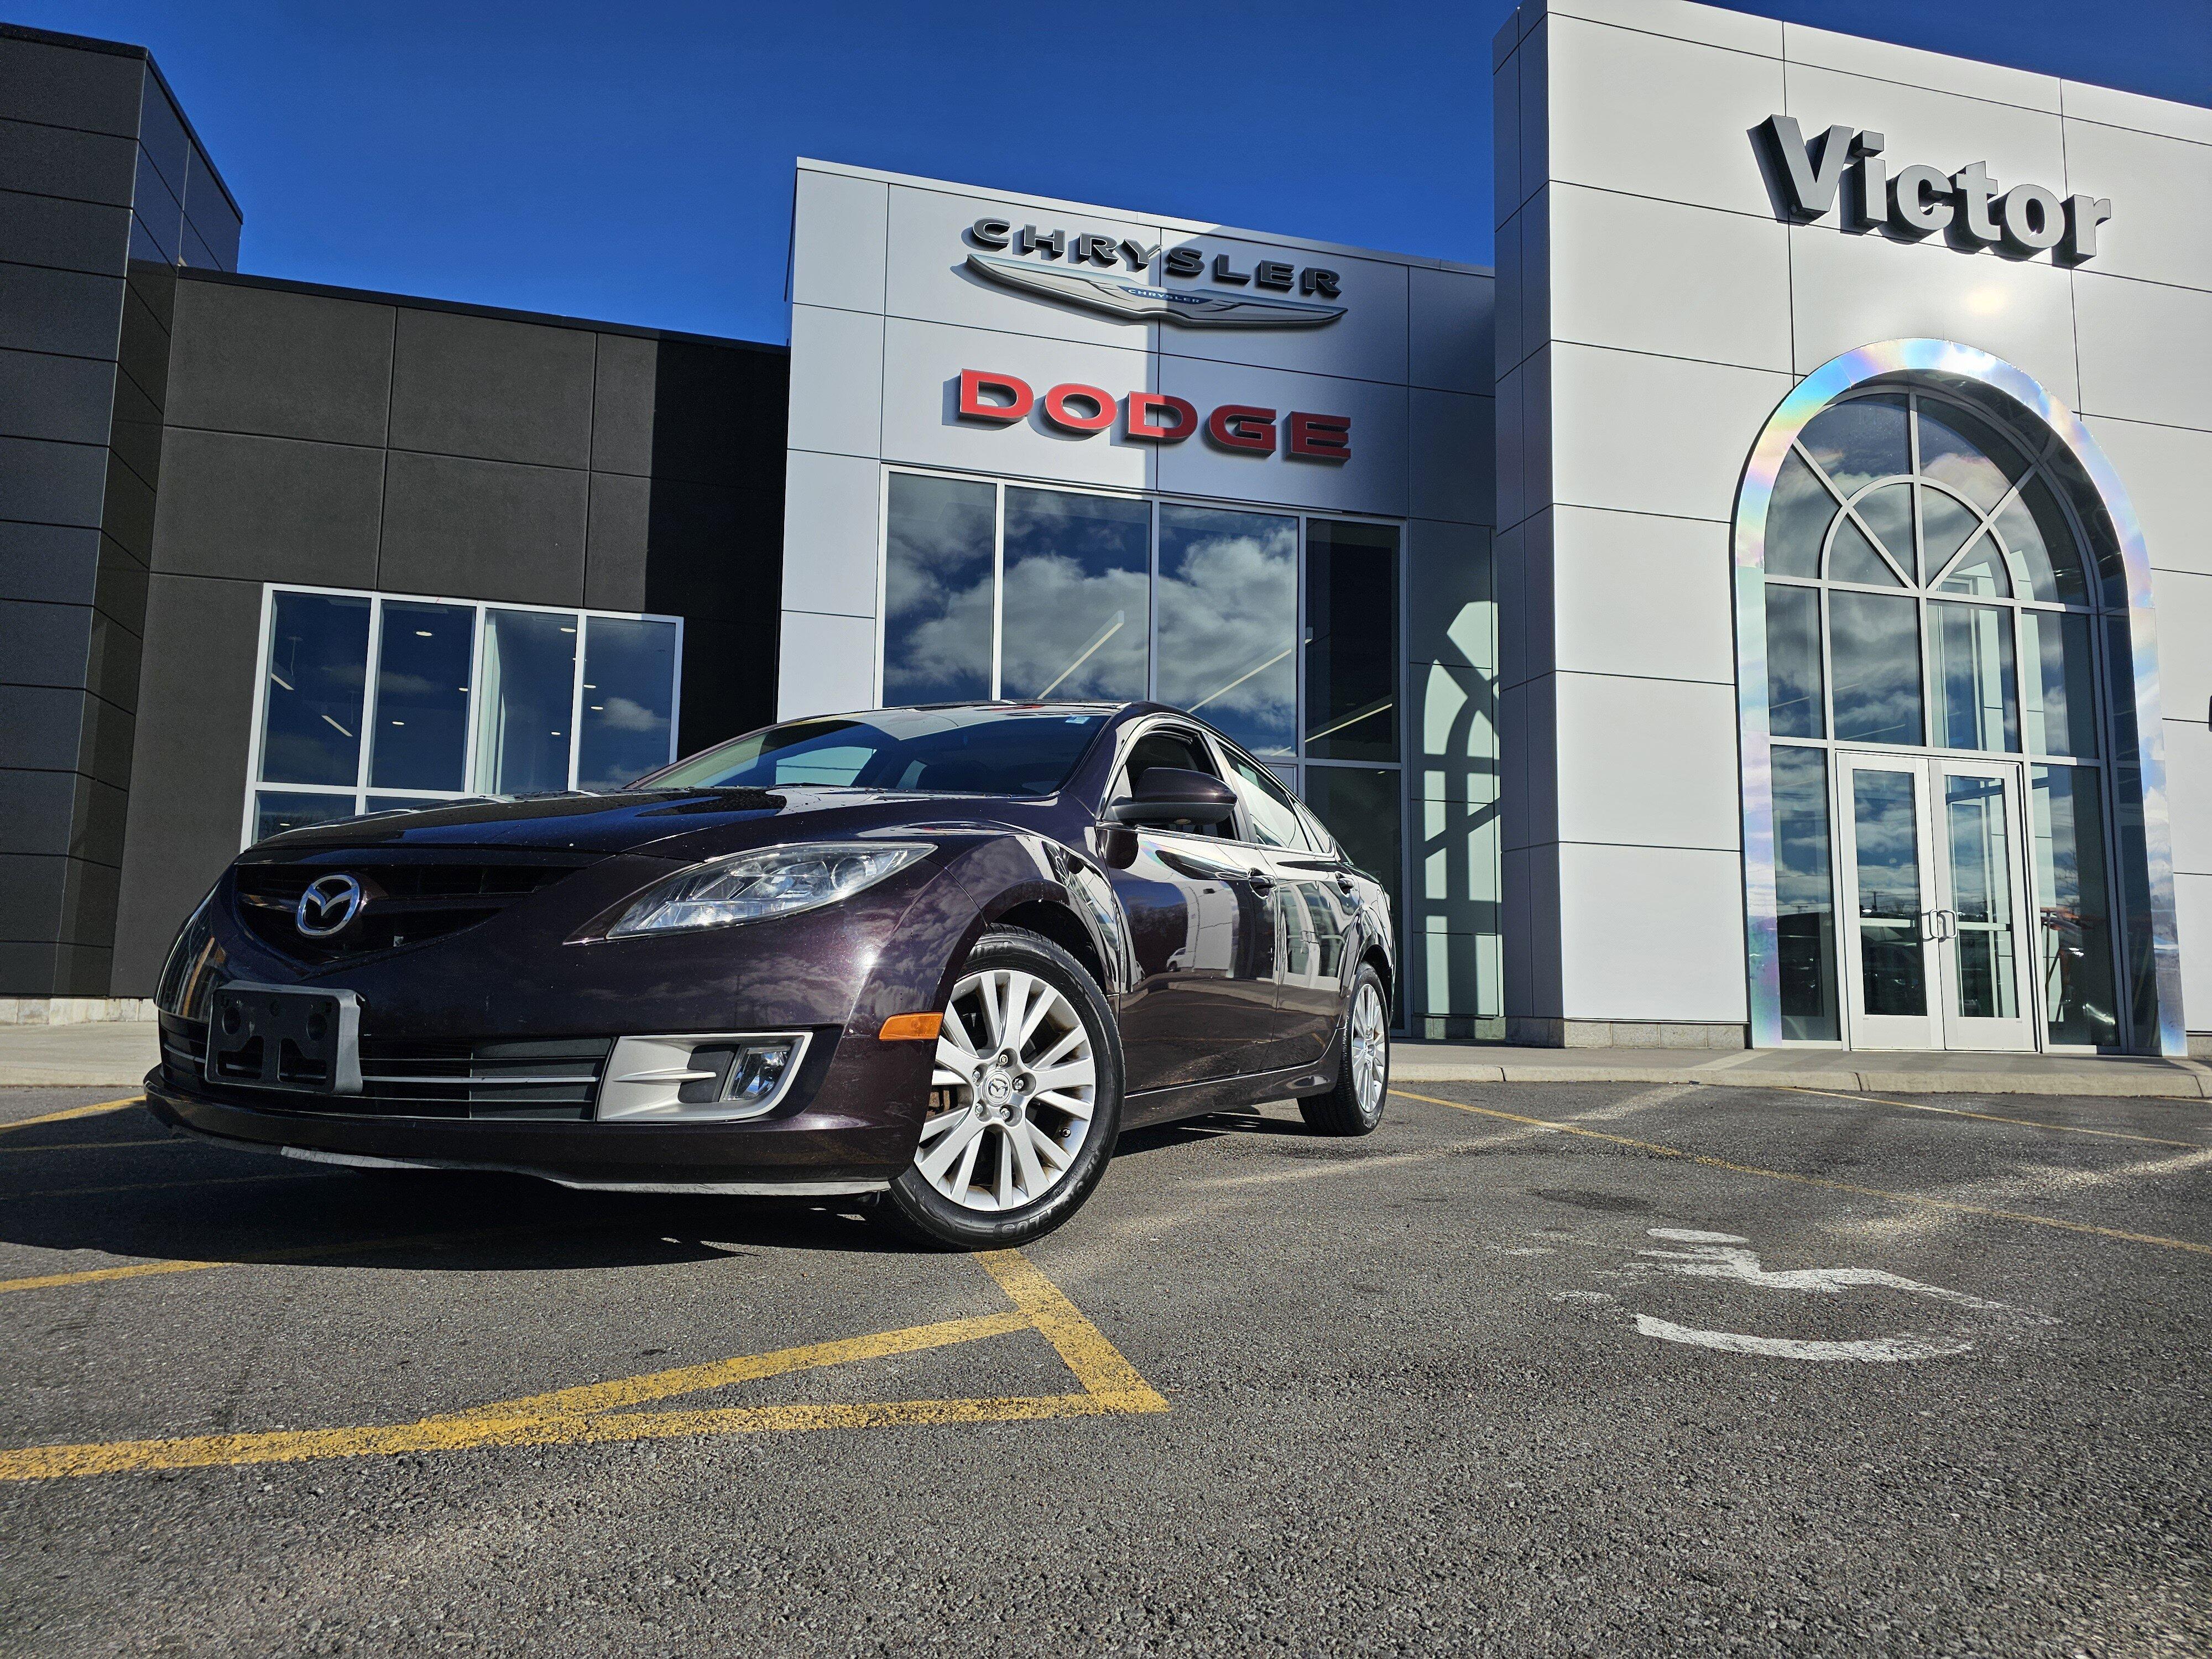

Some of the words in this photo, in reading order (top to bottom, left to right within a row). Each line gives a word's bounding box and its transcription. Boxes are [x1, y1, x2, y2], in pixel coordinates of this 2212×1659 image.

[1747, 114, 2111, 268] Victor
[972, 217, 1342, 298] CHRYSLER
[1128, 289, 1199, 302] CHRYSLER
[960, 368, 1352, 460] DODGE
